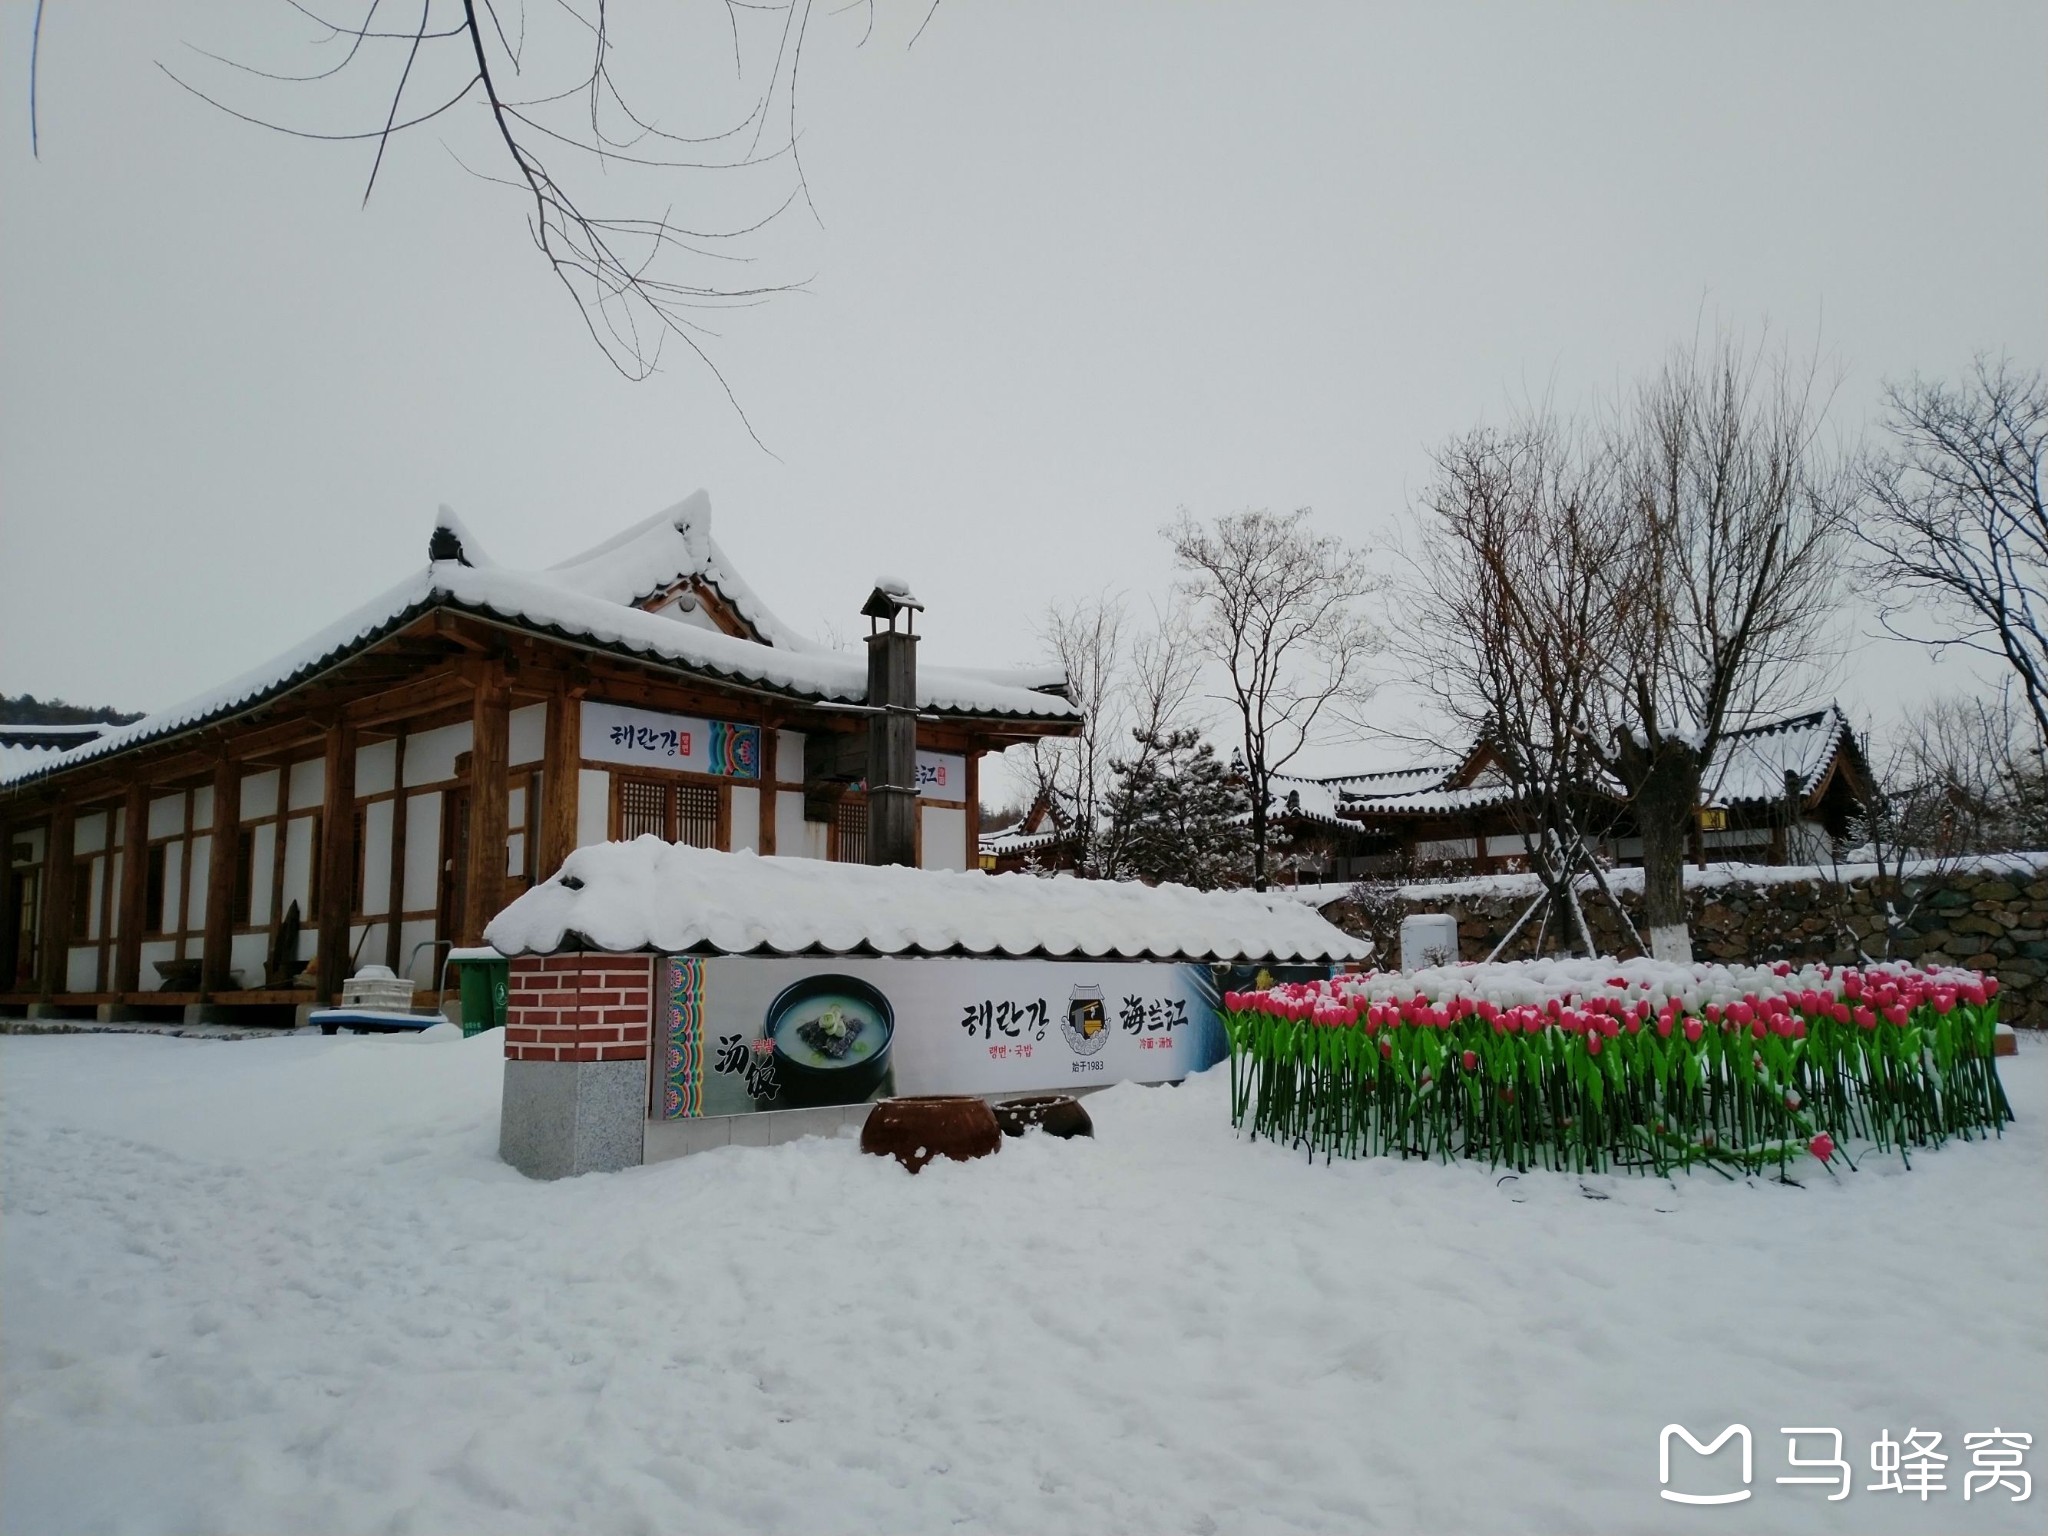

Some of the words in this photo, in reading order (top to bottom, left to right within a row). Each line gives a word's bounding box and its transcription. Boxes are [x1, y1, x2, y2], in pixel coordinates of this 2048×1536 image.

[610, 725, 679, 756] 해란강
[961, 998, 1050, 1041] 해란강
[1119, 994, 1189, 1036] 海兰江
